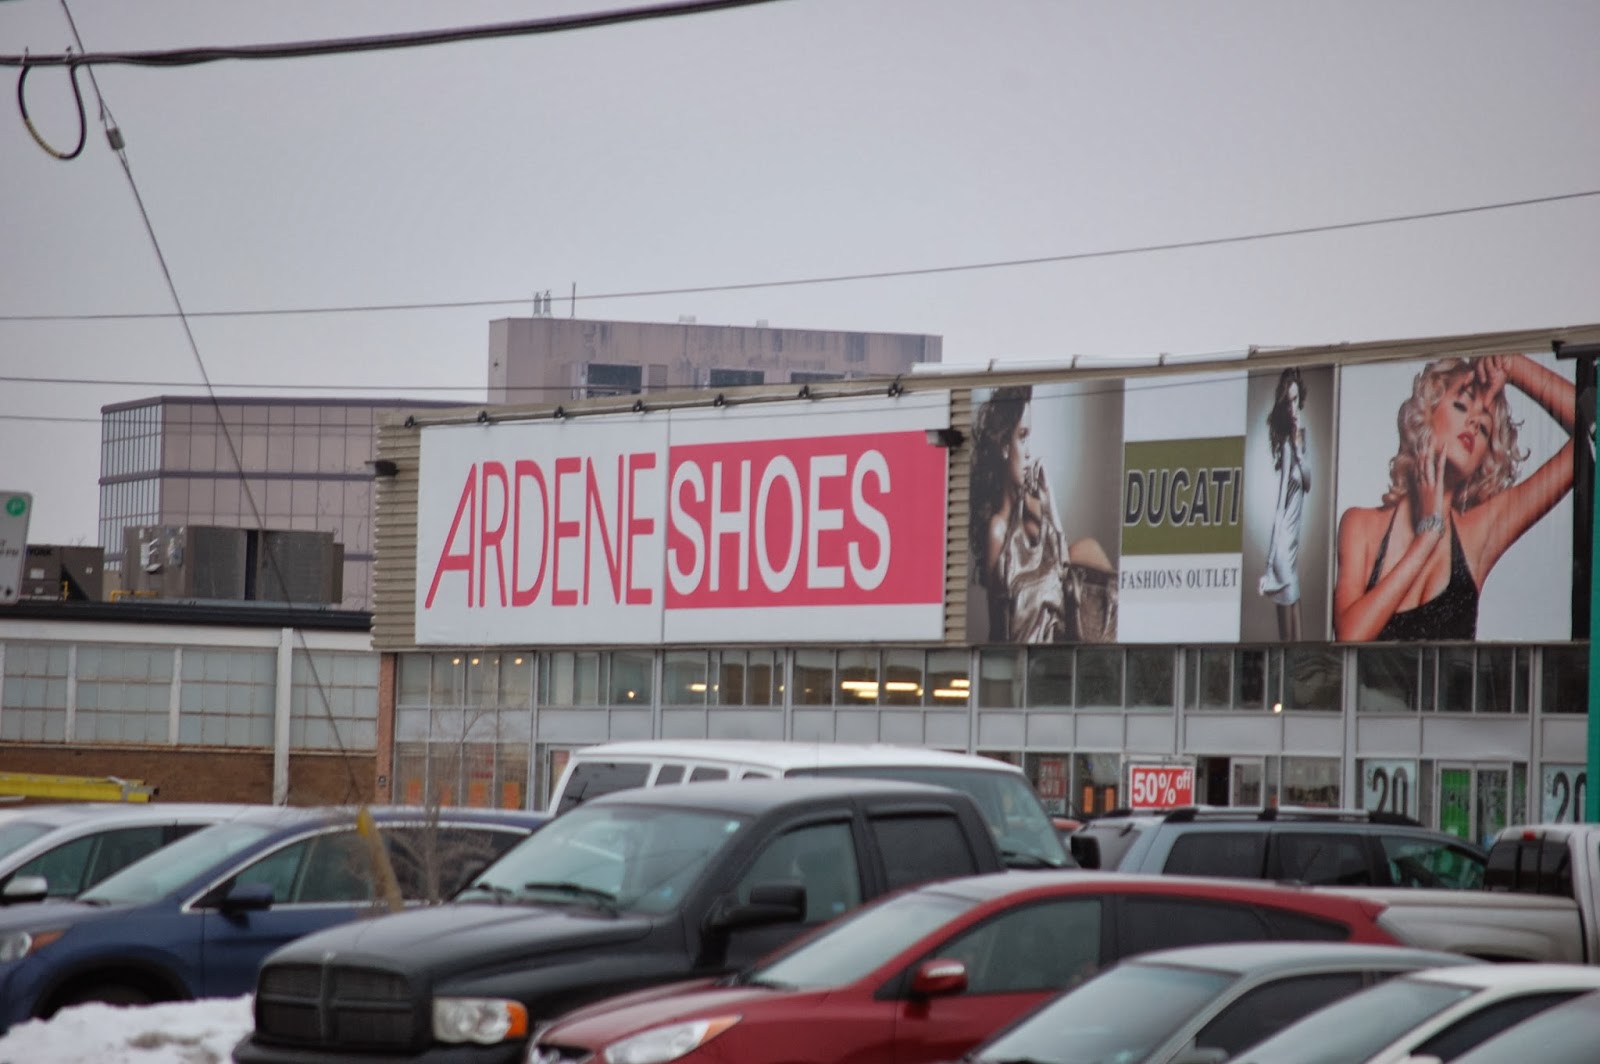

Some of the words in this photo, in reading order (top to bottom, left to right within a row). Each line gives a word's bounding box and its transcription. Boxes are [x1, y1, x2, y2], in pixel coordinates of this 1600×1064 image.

[1123, 467, 1242, 527] DUCATI
[425, 452, 656, 609] ARDENE
[667, 449, 891, 595] SHOES
[1121, 569, 1182, 590] FASHIONS
[1187, 567, 1239, 588] OUTLET
[1133, 772, 1176, 805] 50%
[1176, 770, 1191, 790] off
